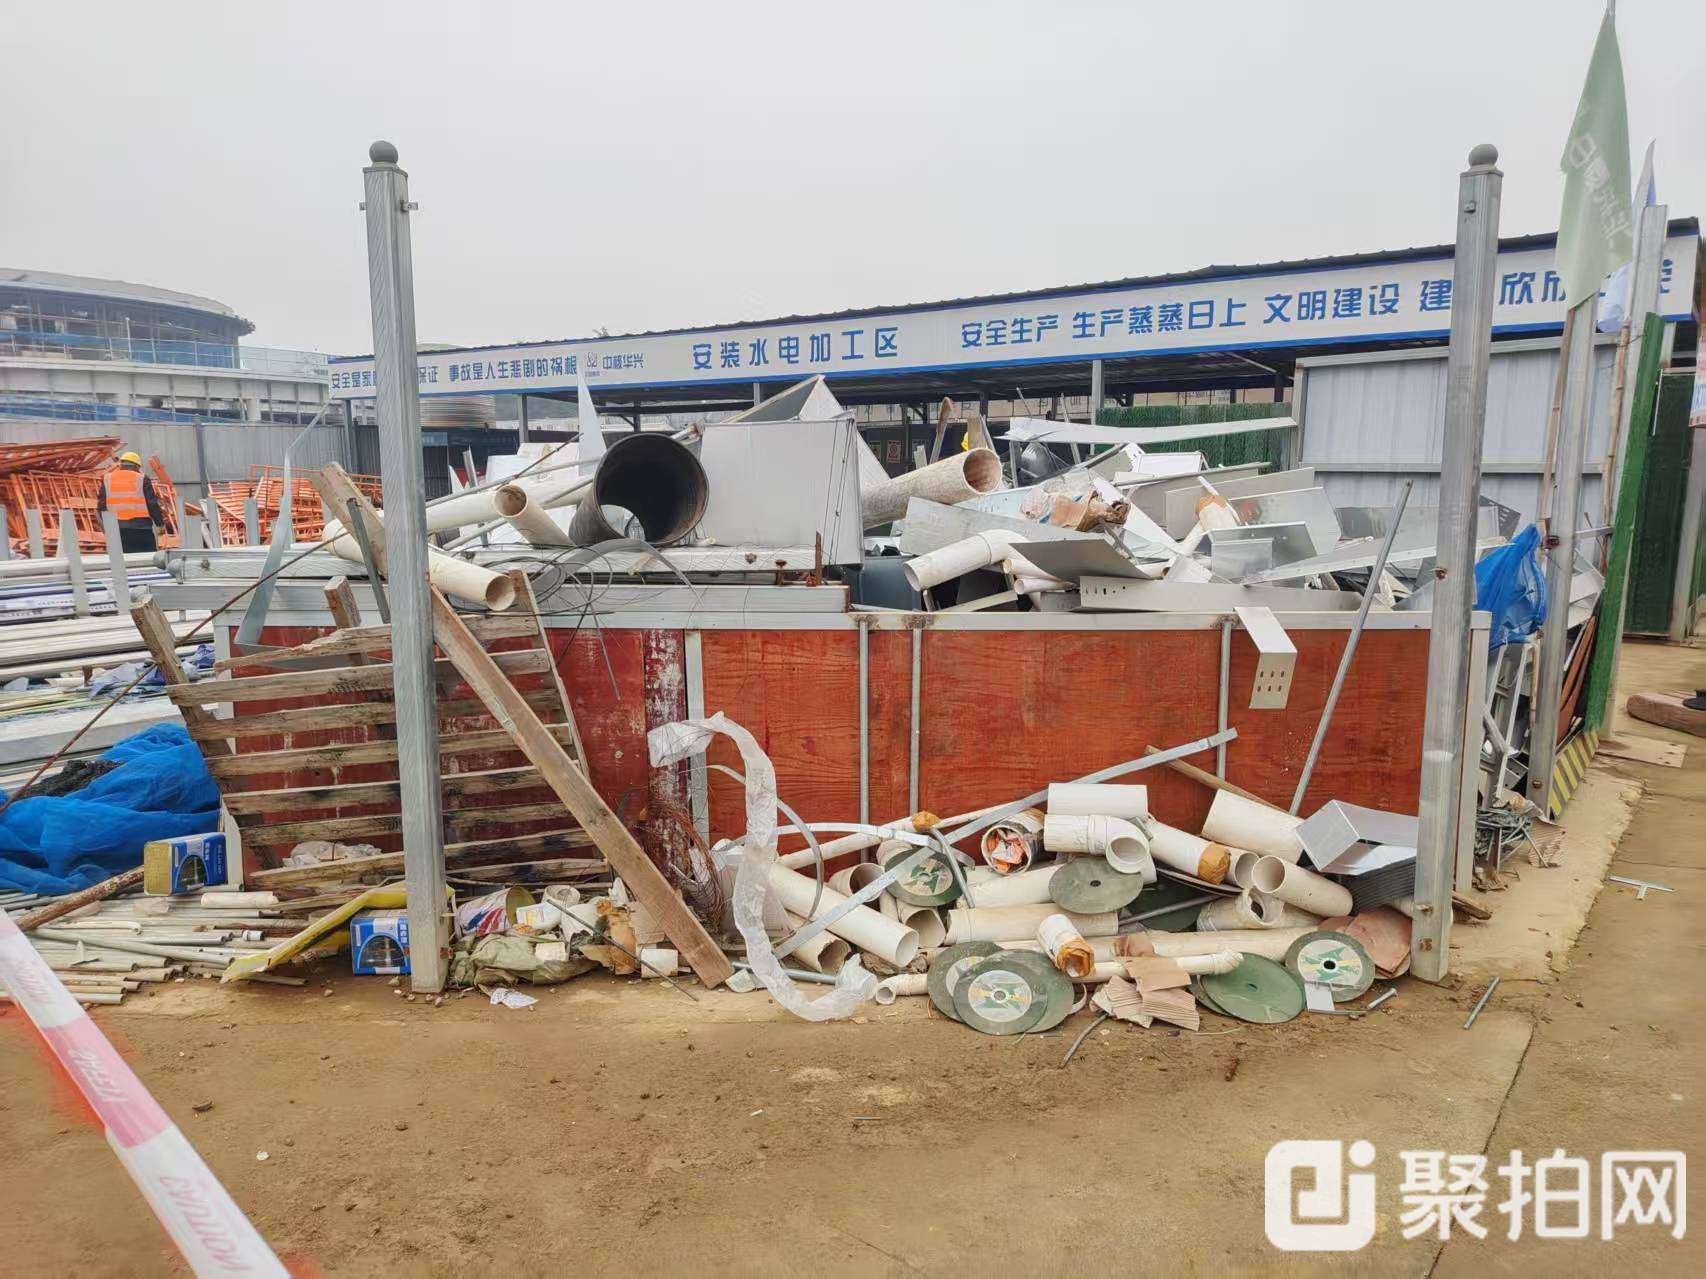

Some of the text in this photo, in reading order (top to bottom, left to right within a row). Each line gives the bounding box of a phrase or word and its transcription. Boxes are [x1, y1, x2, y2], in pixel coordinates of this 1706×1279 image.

[961, 313, 1059, 349] 安全生产
[1072, 297, 1248, 341] 生产蒸蒸日上
[1263, 282, 1402, 326] 文明建设
[602, 353, 644, 370] 中核华兴
[692, 326, 900, 371] 安装水电加工区
